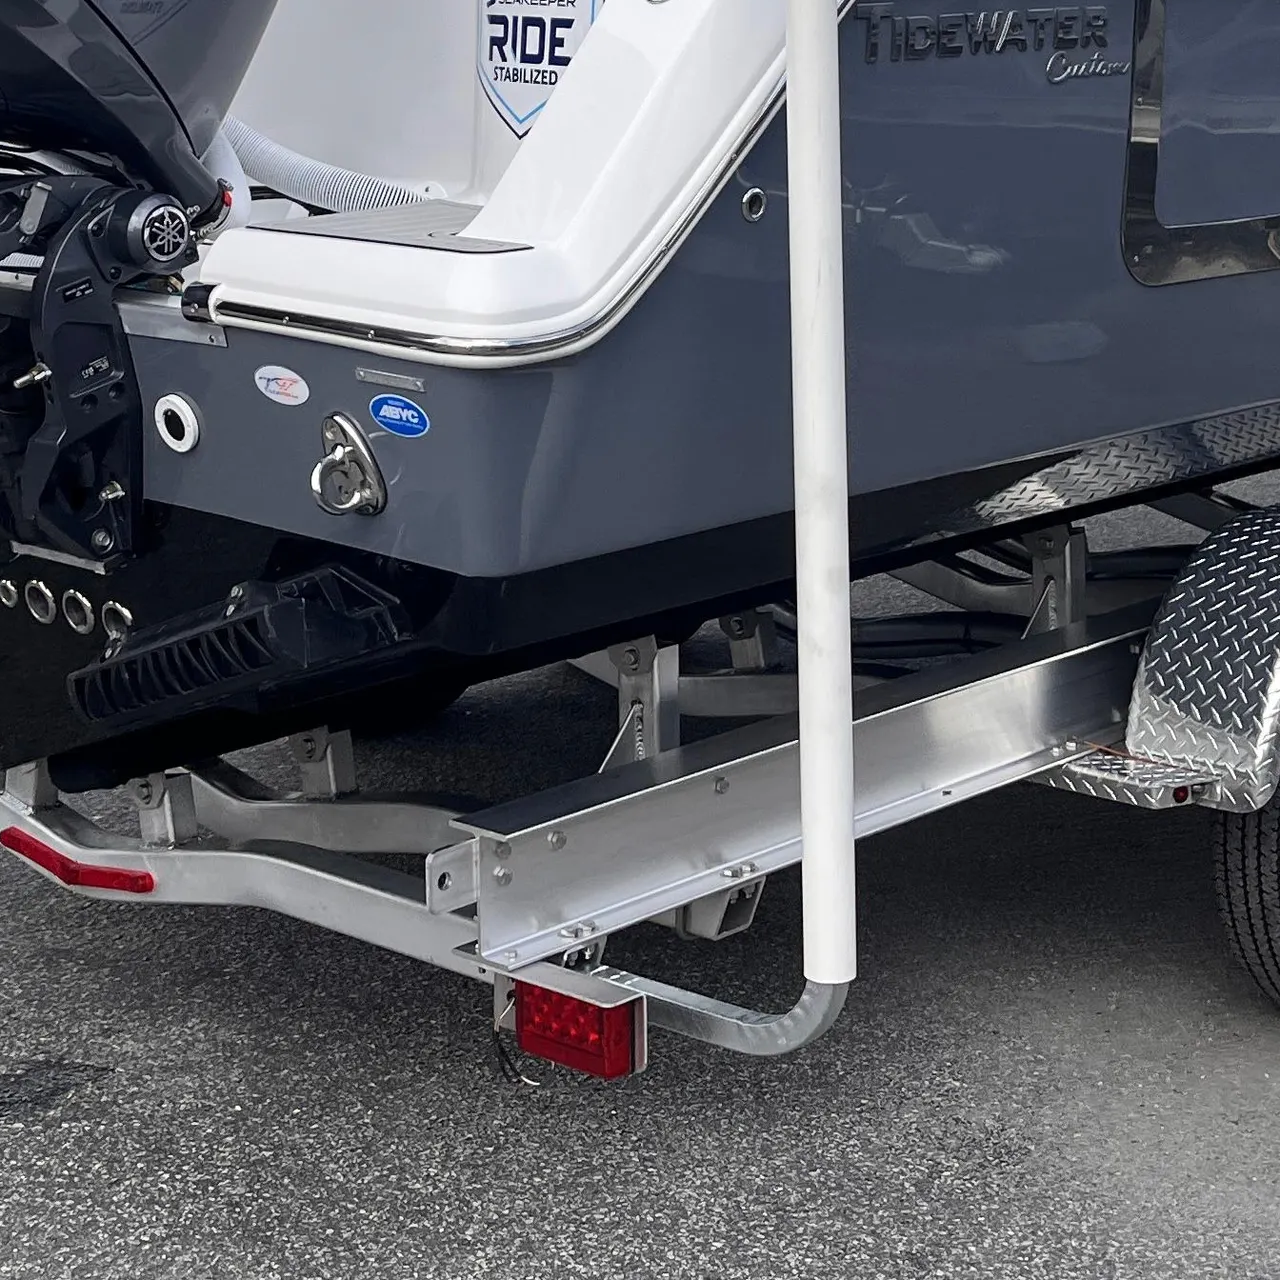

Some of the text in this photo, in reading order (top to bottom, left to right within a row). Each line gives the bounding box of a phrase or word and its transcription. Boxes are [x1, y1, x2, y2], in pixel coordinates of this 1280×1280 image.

[487, 14, 575, 66] RIDE
[856, 1, 1109, 65] TIDEWATER
[493, 66, 559, 86] STABILIZED
[378, 404, 420, 424] ABYC
